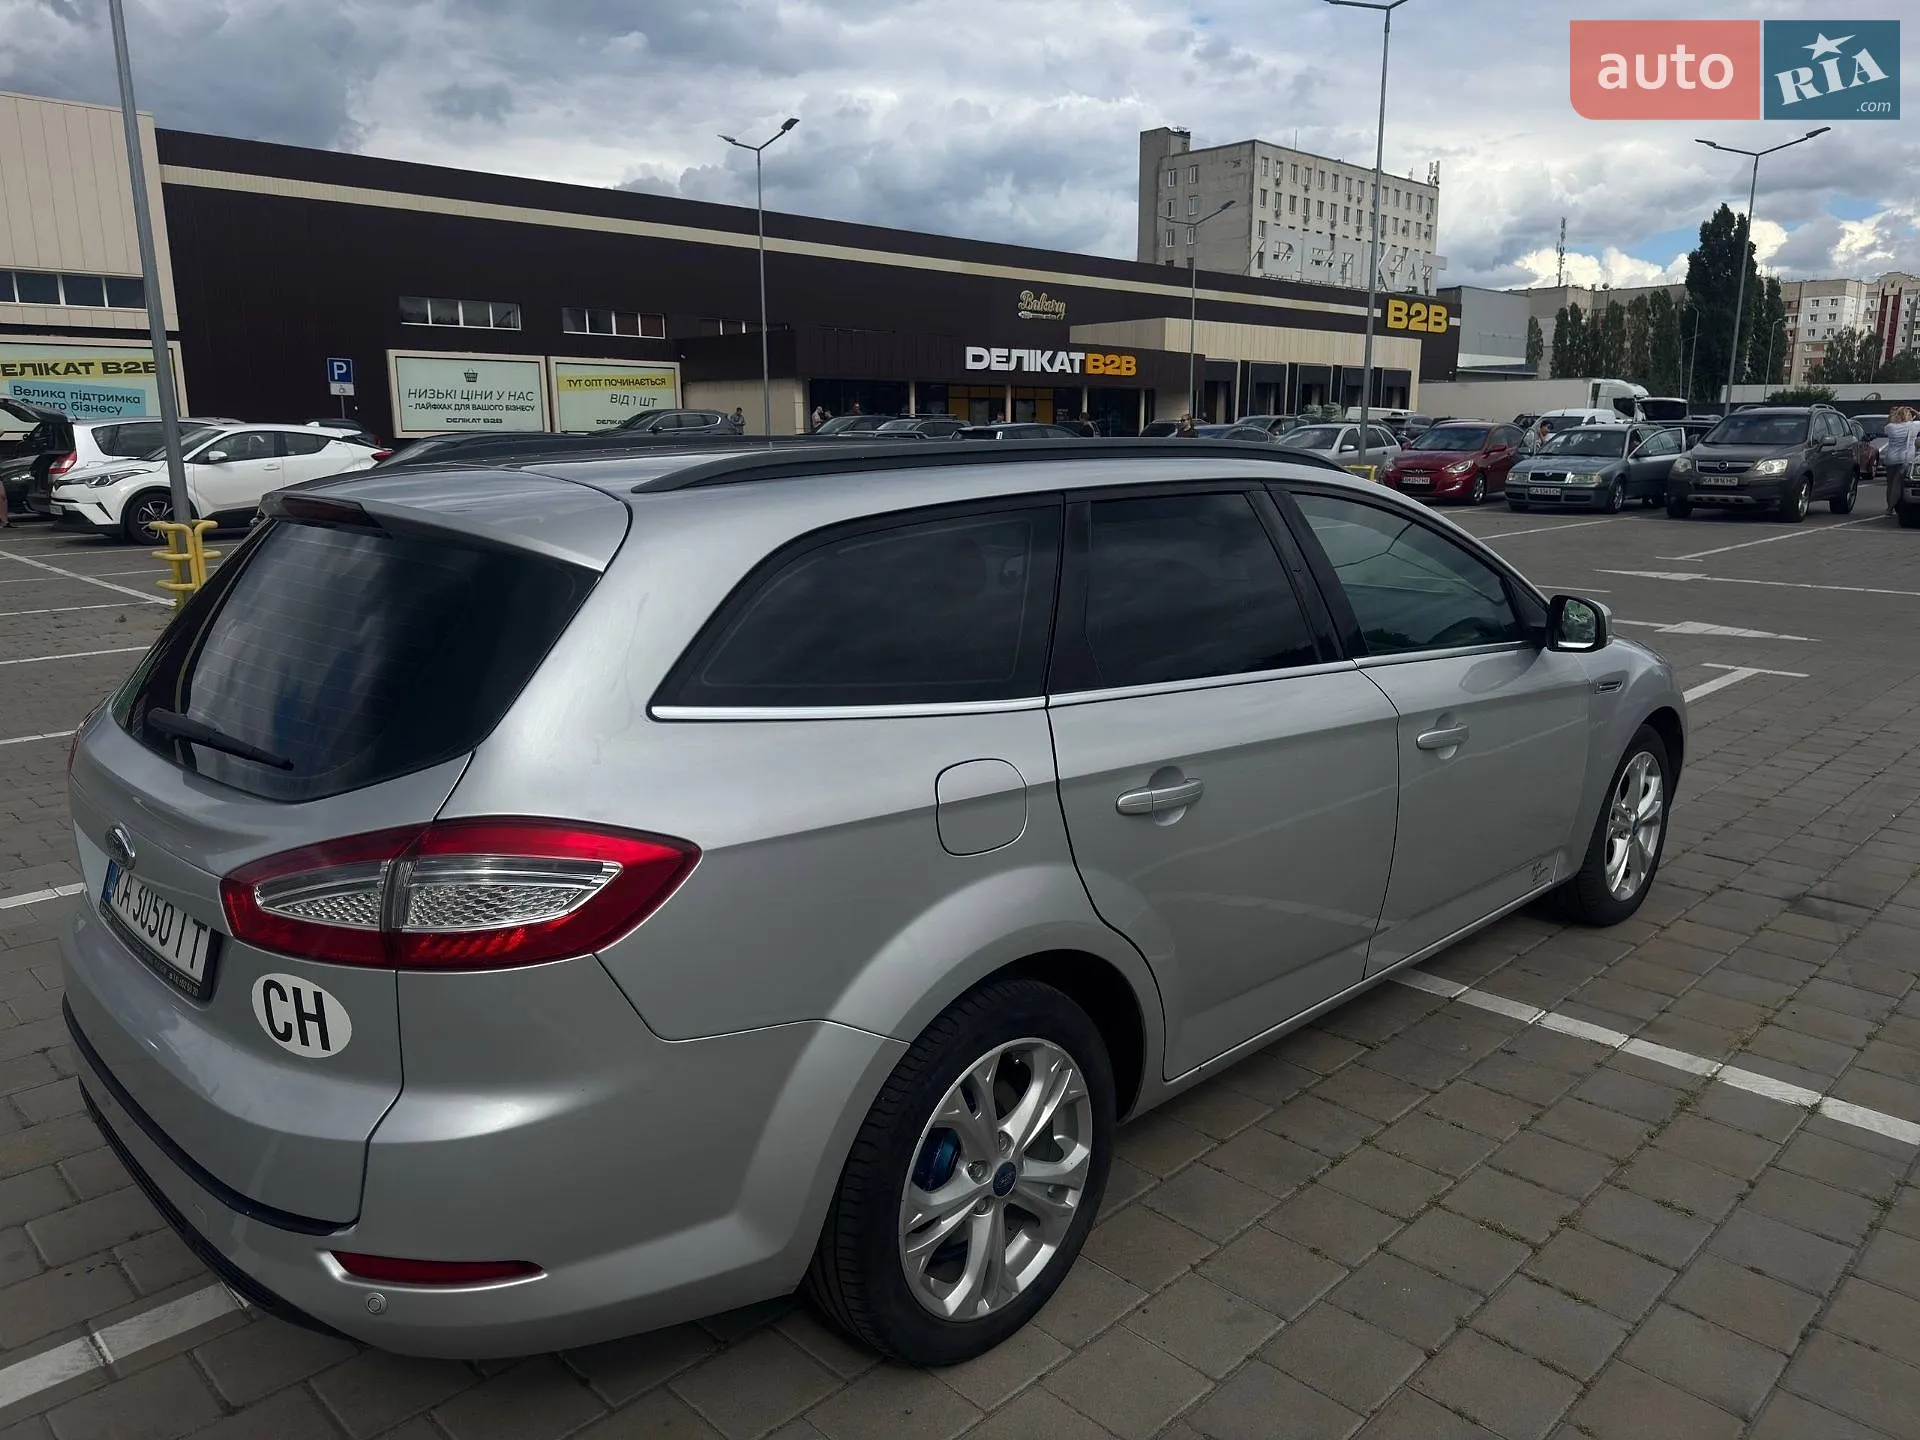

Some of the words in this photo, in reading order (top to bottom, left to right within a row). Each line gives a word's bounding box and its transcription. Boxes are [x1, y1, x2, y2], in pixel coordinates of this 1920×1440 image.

[1018, 290, 1066, 320] Bakery
[1386, 299, 1448, 334] B2B
[0, 361, 95, 377] ЕЛІКАТ
[333, 361, 347, 380] P
[1085, 353, 1137, 376] B2B
[567, 379, 582, 388] ТУТ
[584, 379, 602, 387] ОПТ
[604, 378, 666, 386] ПОЧИНАЄТЬСЯ
[13, 385, 66, 398] Велика
[70, 389, 141, 404] підтримка
[407, 388, 457, 400] НИЗЬКІ
[460, 389, 493, 401] ЦІНИ
[496, 391, 506, 401] У
[507, 391, 535, 401] НАС
[610, 393, 629, 406] ВІД
[639, 397, 658, 407] ШТ
[71, 400, 123, 415] бізнесу
[414, 402, 453, 411] ЛАЙФХАК
[454, 404, 470, 412] ДЛЯ
[471, 404, 504, 412] ВАШОГО
[505, 404, 535, 412] БІЗНЕСУ
[175, 912, 208, 969] IT
[262, 979, 331, 1052] CH
